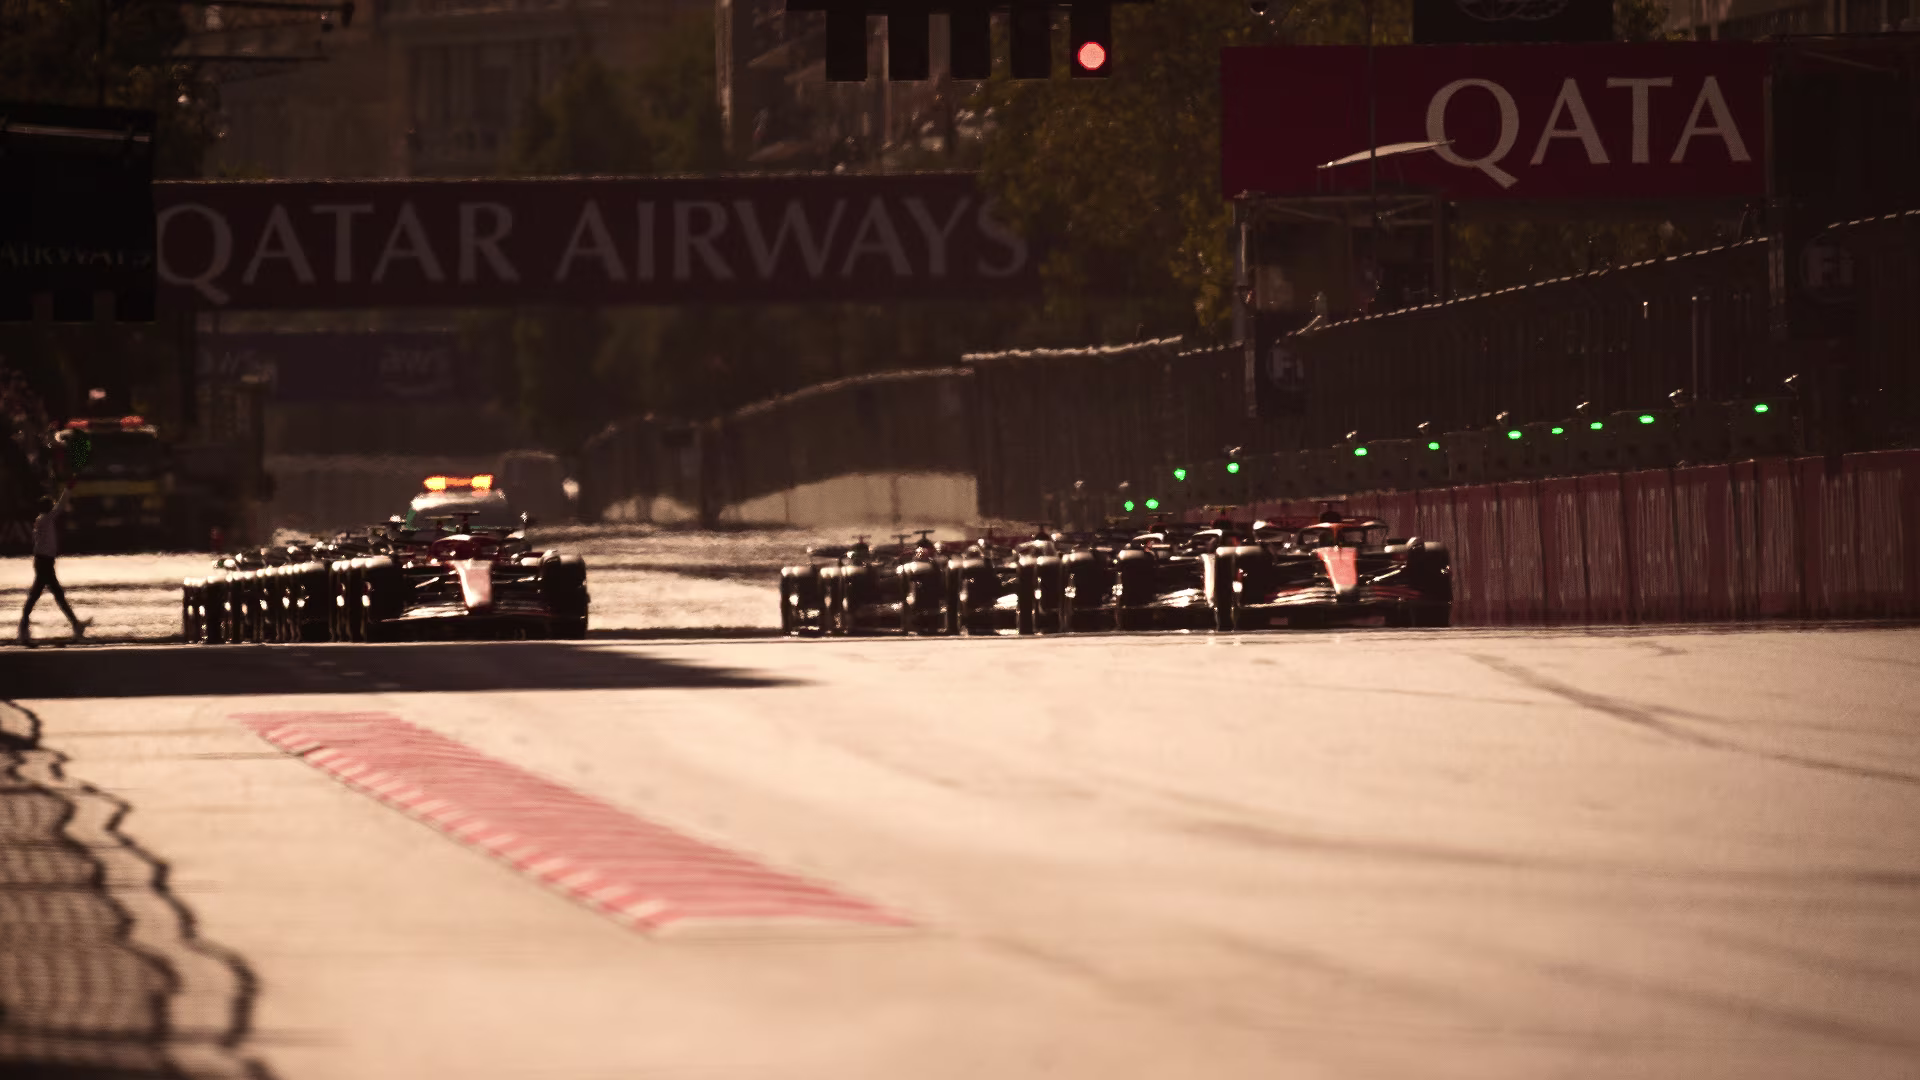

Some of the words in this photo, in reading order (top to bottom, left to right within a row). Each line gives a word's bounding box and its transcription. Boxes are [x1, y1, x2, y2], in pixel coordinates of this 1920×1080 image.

[1425, 75, 1752, 189] QATA
[157, 199, 520, 305] QATAR
[553, 195, 1029, 284] AIRWAYS
